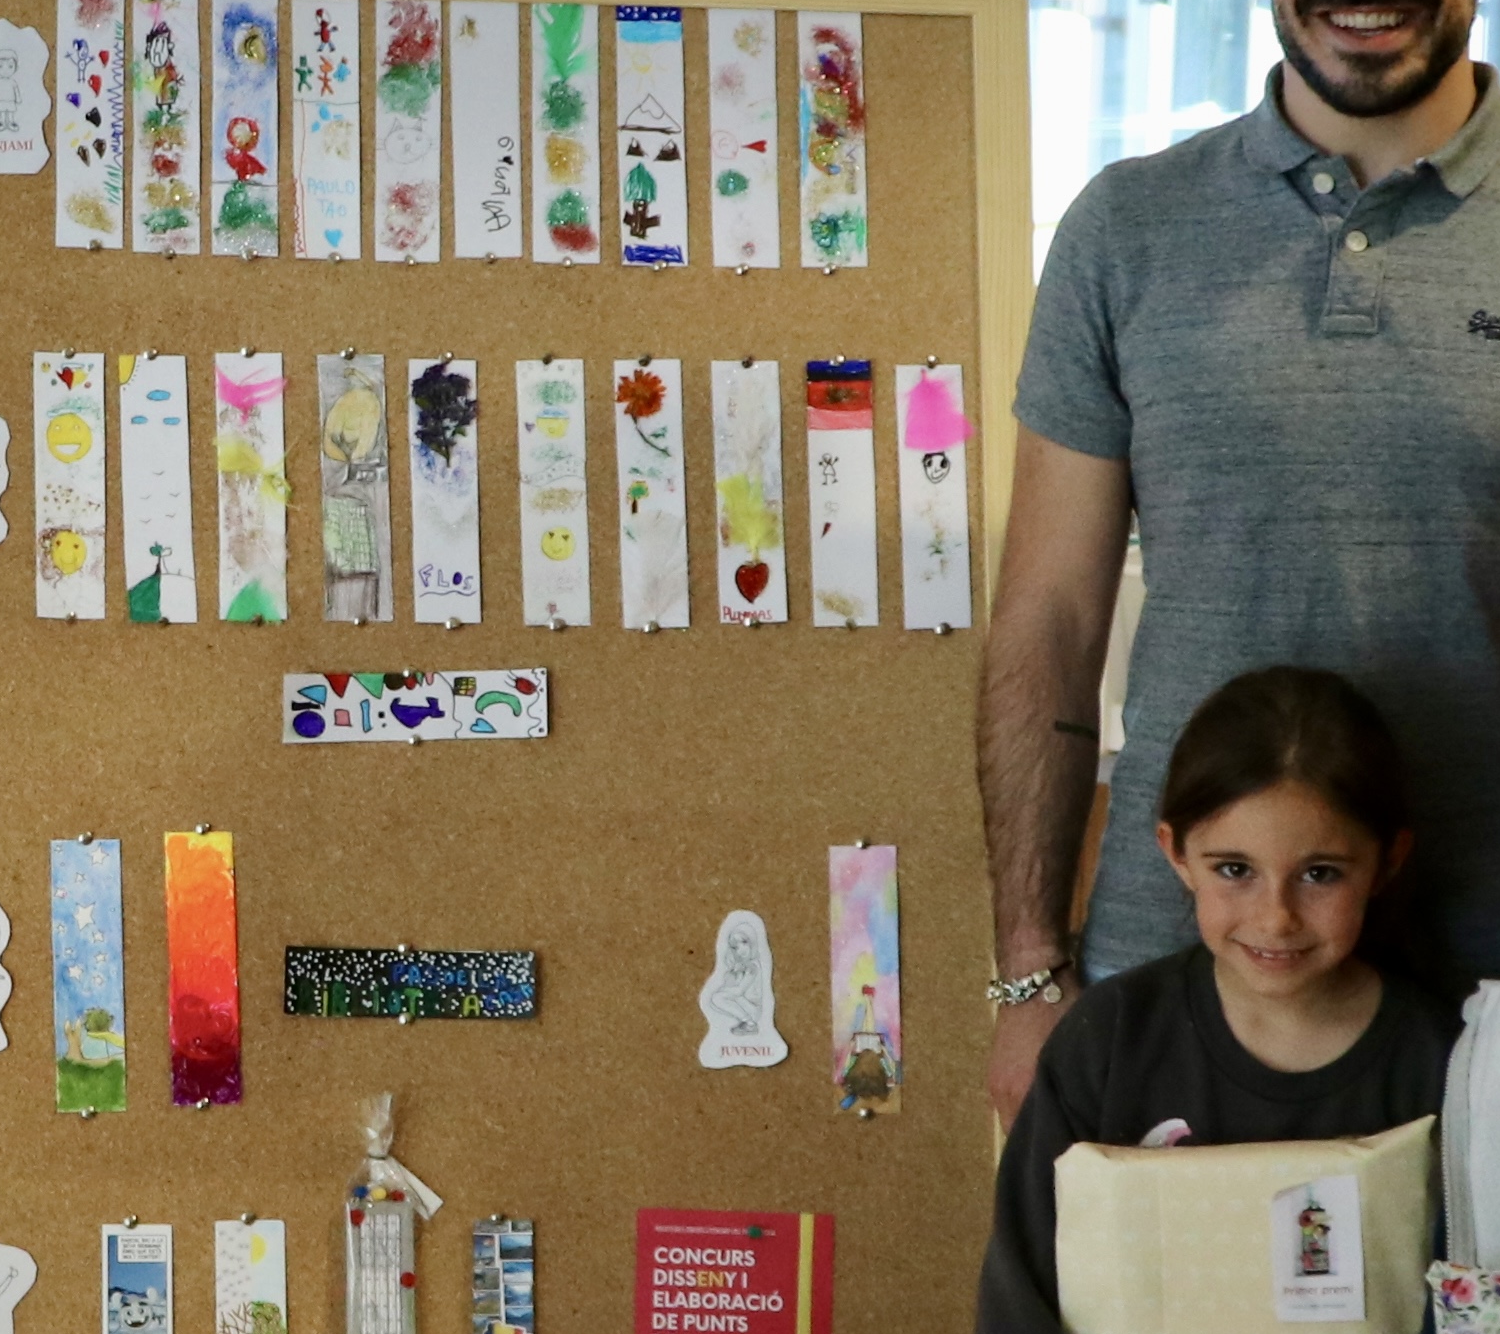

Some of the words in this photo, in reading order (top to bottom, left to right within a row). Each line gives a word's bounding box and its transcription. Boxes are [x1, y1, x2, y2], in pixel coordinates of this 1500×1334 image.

[720, 1046, 775, 1058] JUVENIL
[654, 1247, 756, 1267] CONCURS
[653, 1268, 737, 1288] DISSENY
[742, 1272, 748, 1288] I
[653, 1290, 784, 1312] ELABORACIÓ
[652, 1313, 679, 1330] DE
[683, 1313, 749, 1333] PUNTS
